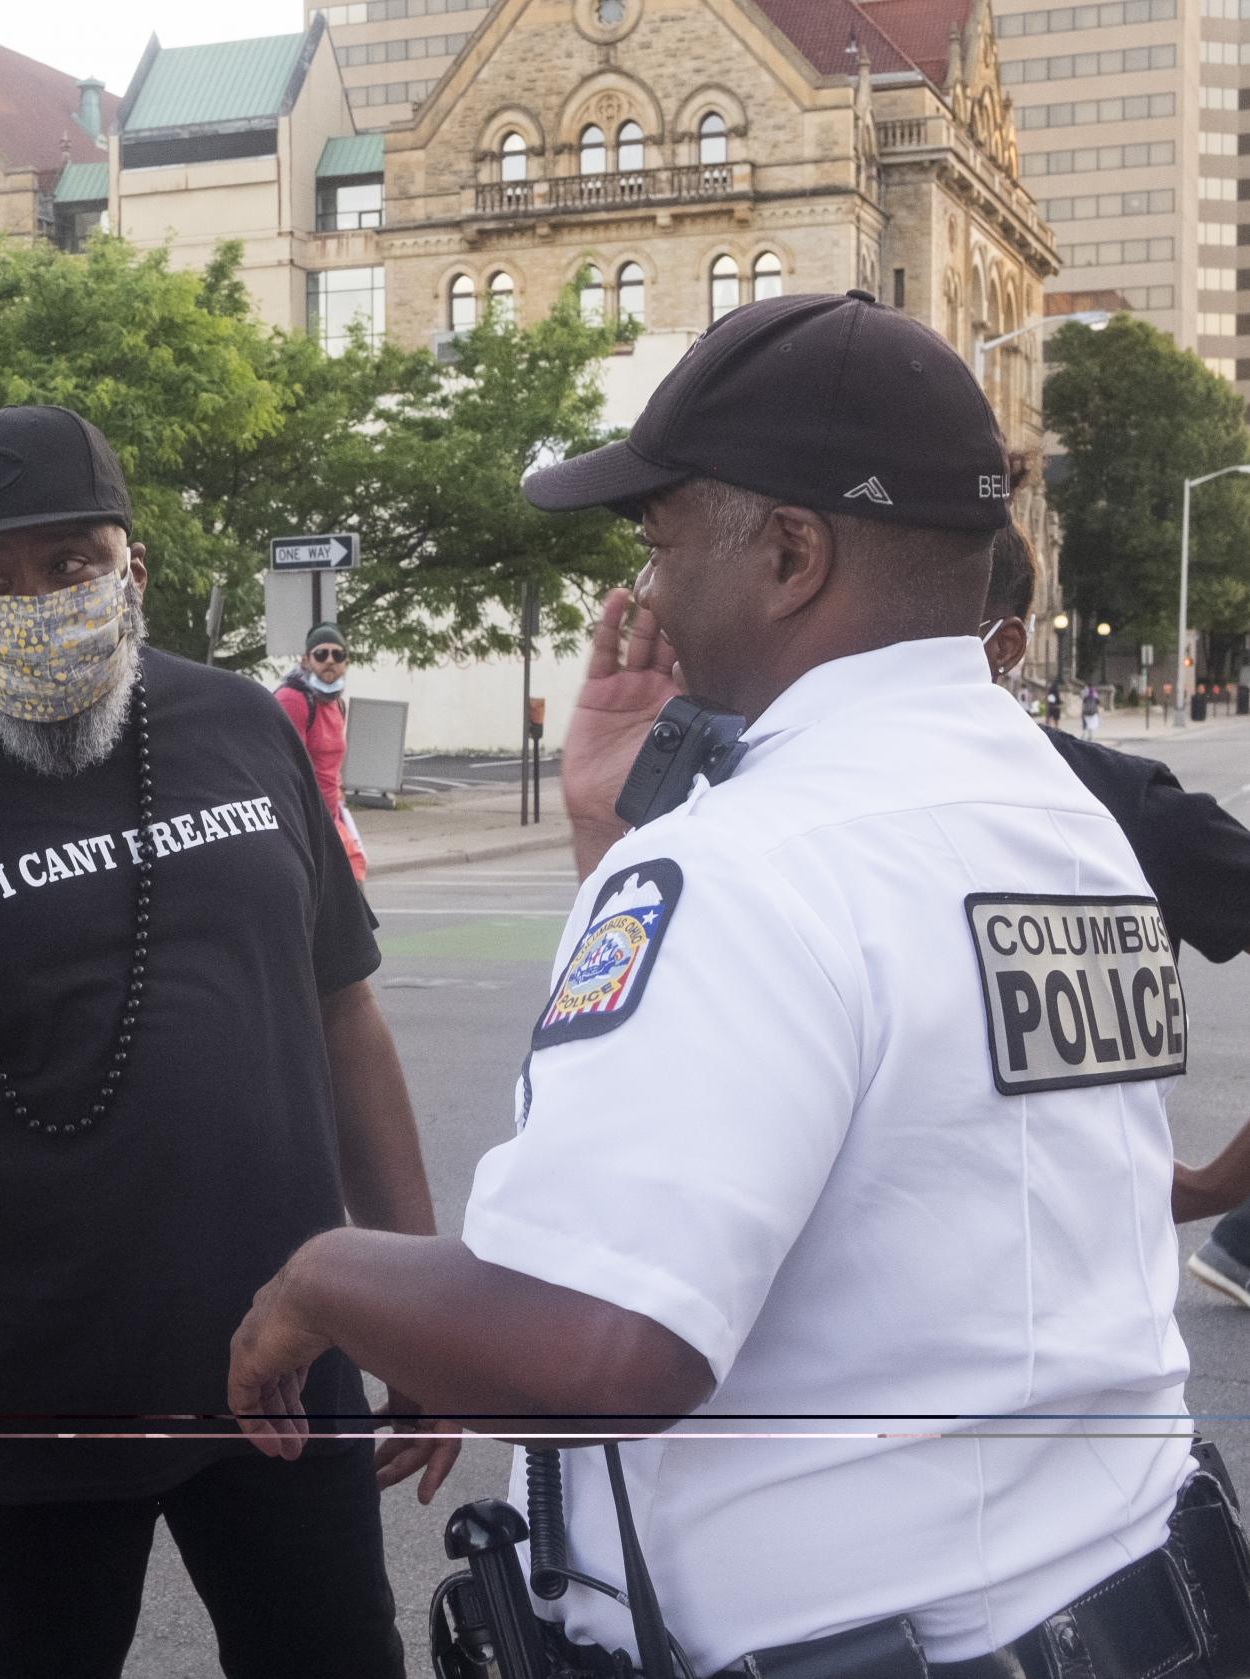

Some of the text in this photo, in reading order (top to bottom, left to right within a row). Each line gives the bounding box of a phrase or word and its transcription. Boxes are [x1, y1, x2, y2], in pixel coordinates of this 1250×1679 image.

[278, 546, 331, 561] ONE WAY
[18, 834, 118, 887] CANT
[986, 915, 1170, 956] COLUMBUS
[560, 981, 615, 1010] POLICE
[996, 966, 1183, 1072] POLICE
